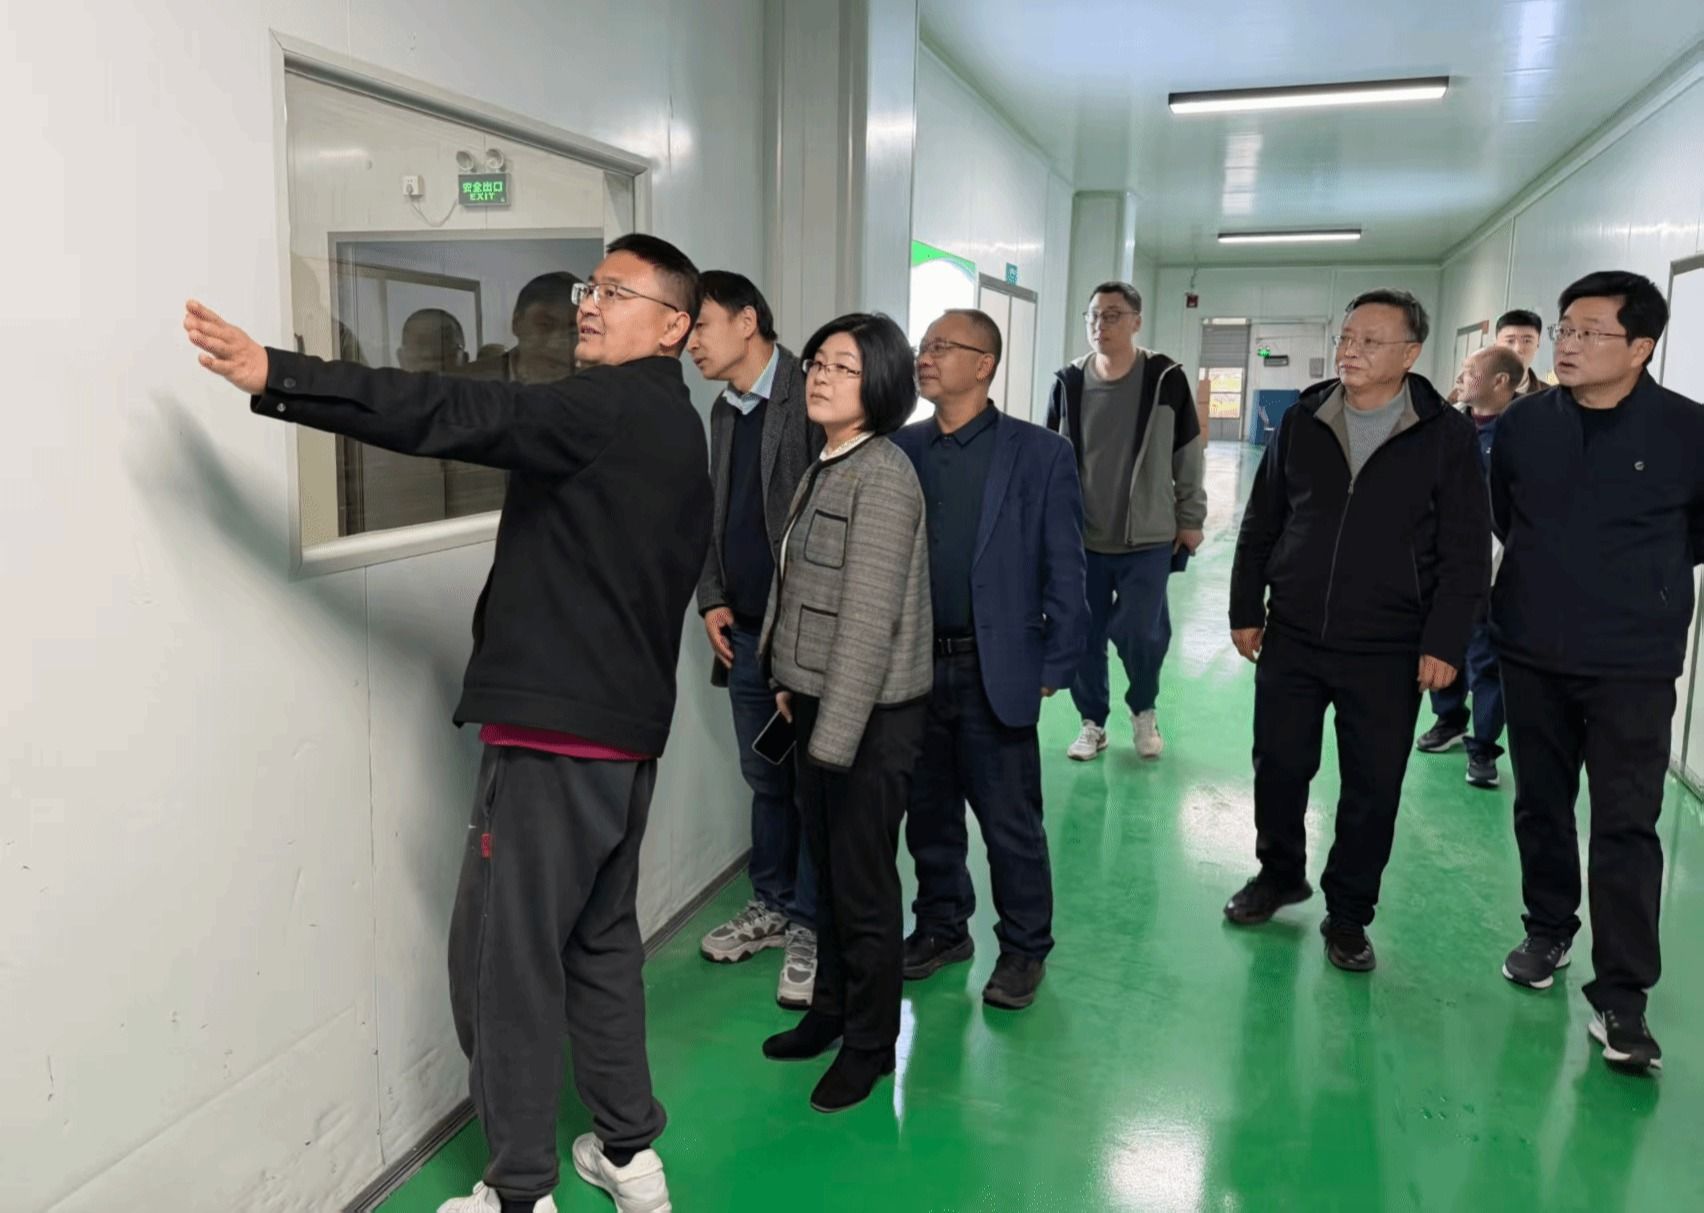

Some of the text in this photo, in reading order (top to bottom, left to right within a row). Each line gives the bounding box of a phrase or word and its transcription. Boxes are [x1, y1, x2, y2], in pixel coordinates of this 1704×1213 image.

[463, 181, 503, 193] 安全出口
[470, 192, 496, 201] EXIT
